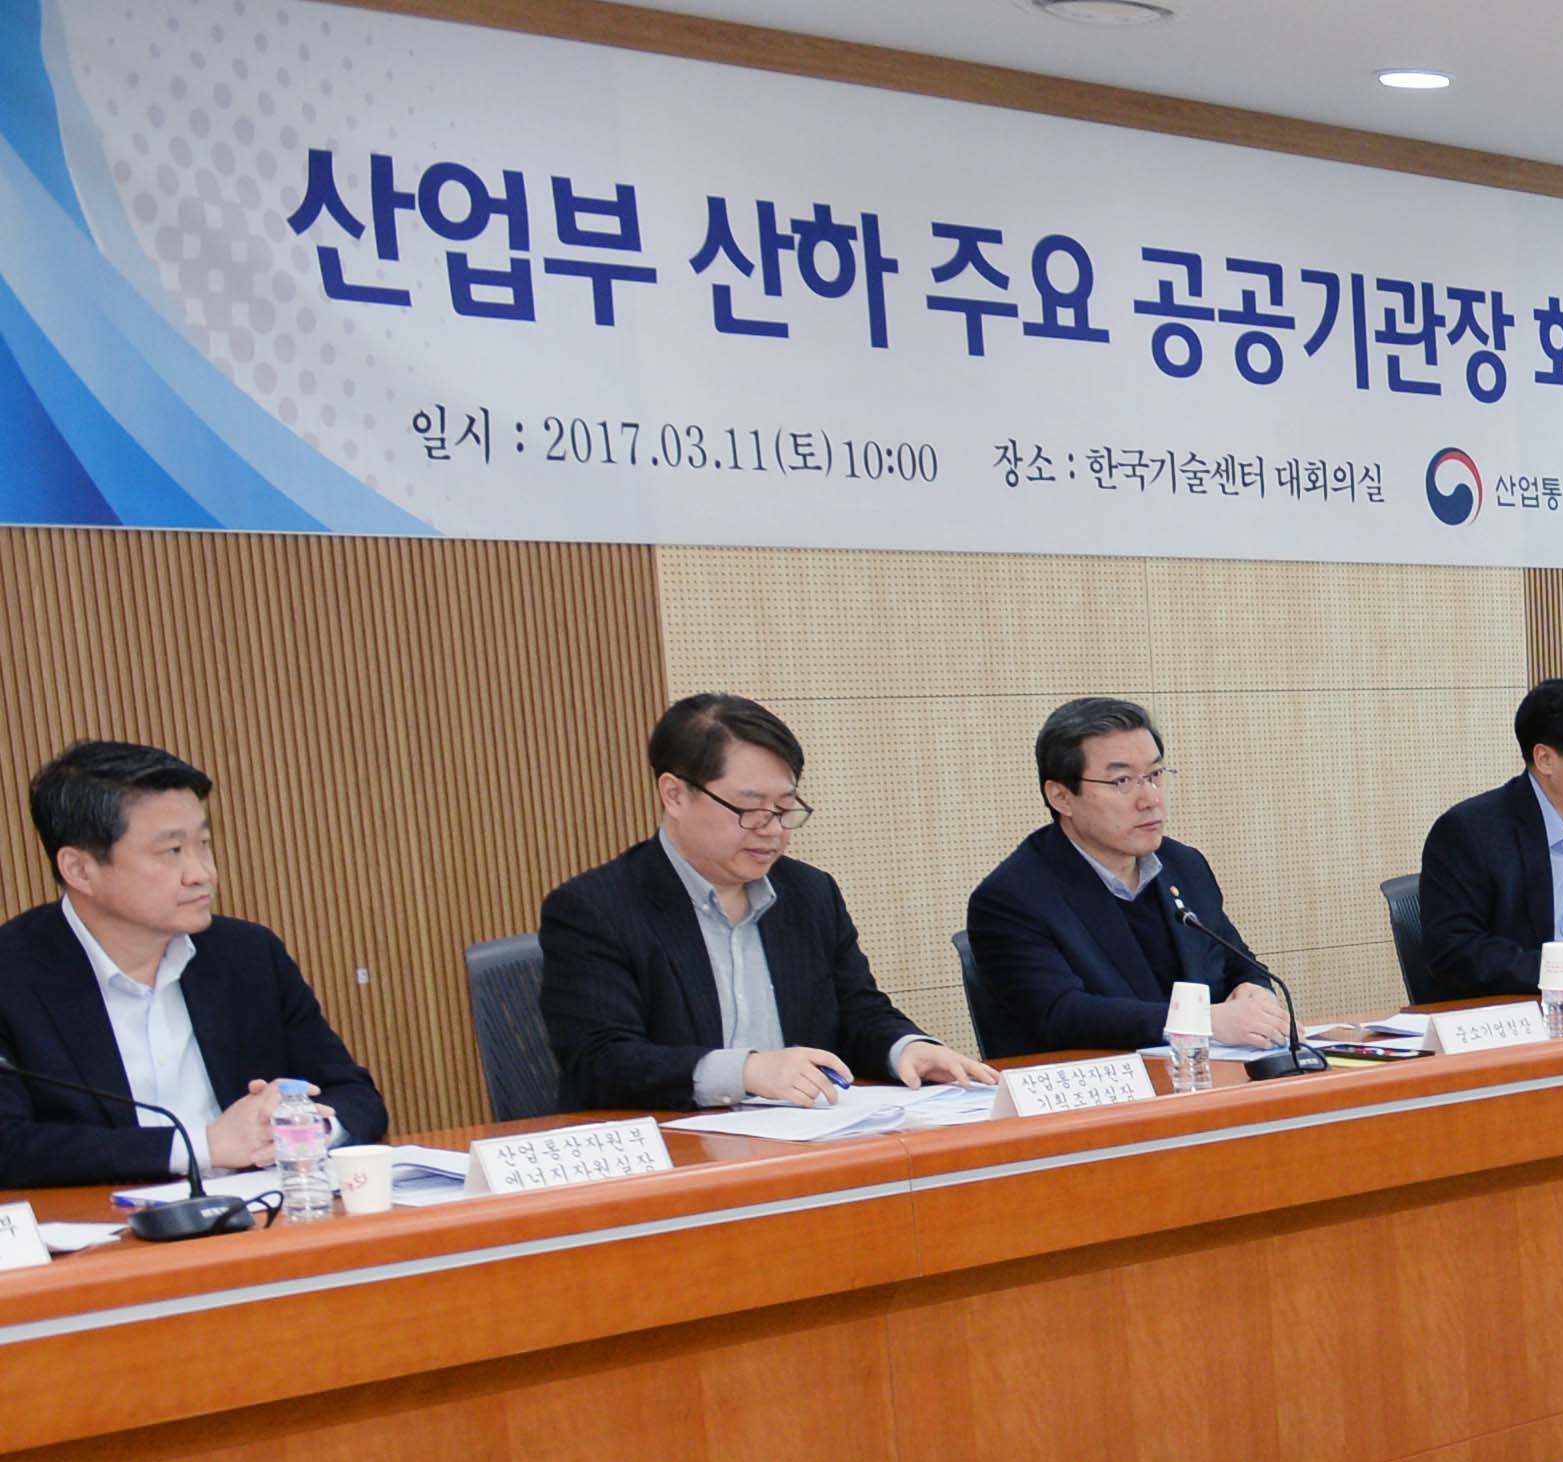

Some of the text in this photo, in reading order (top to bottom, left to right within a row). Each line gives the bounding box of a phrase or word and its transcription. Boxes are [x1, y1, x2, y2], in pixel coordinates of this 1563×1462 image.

[285, 146, 658, 328] 산업부
[687, 194, 901, 350] 산하
[924, 220, 1112, 358] 주요
[1132, 245, 1517, 405] 공공기관장
[411, 402, 492, 466] 일시
[842, 439, 939, 483] 10:00
[993, 437, 1057, 489] 장소
[1084, 445, 1266, 500] 한국기술센터
[1273, 456, 1386, 504] 대회의실
[498, 1128, 646, 1167] 산업통상자원부
